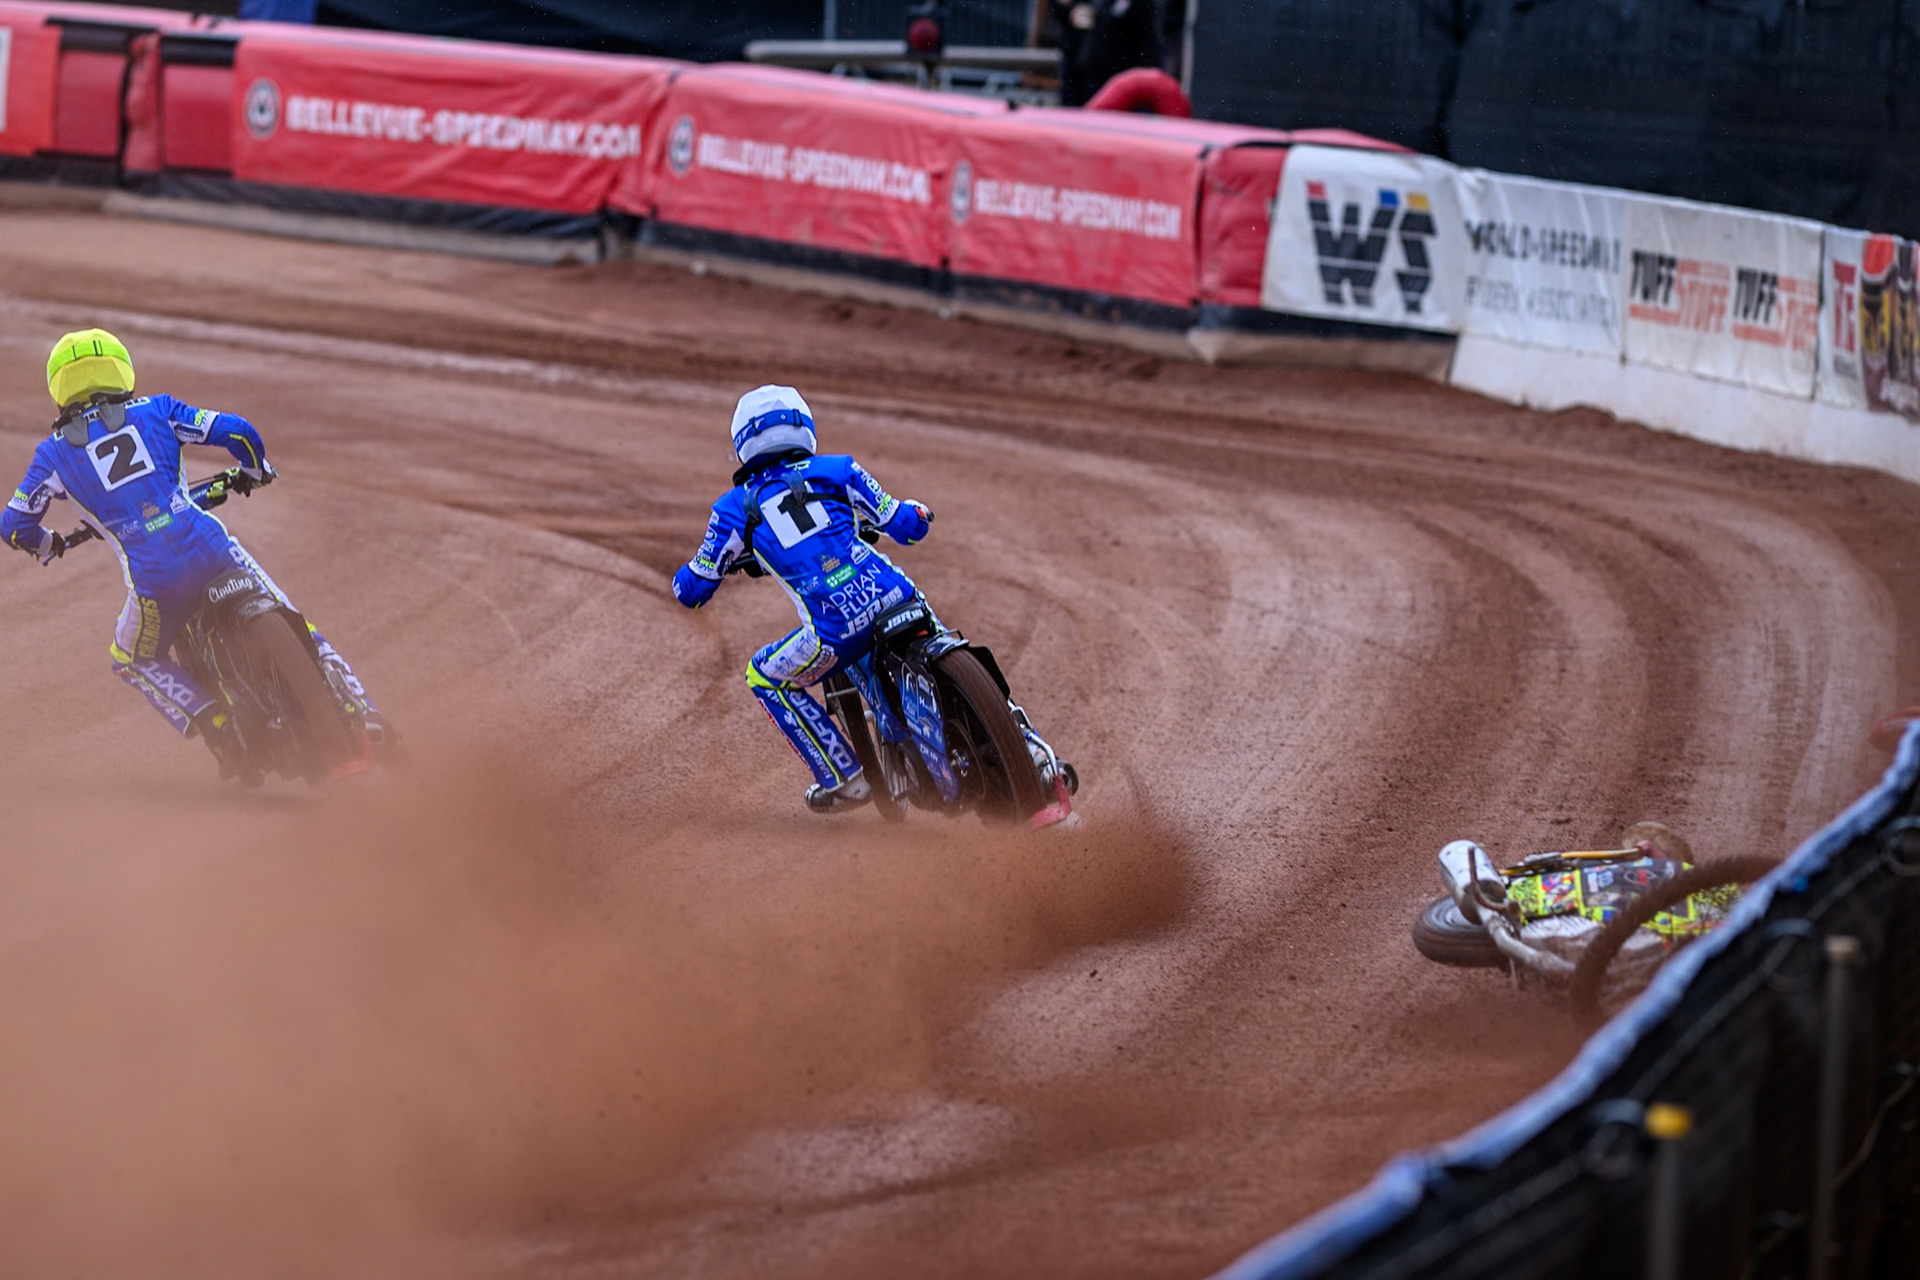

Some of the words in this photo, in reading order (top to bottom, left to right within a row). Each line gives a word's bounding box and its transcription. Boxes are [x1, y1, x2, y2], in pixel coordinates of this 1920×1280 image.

[1630, 250, 1677, 305] TUFF
[1734, 266, 1777, 323] TUFF
[95, 433, 147, 485] 2
[777, 491, 817, 535] 1
[822, 564, 881, 614] ADRIAN
[840, 581, 883, 619] FLUX
